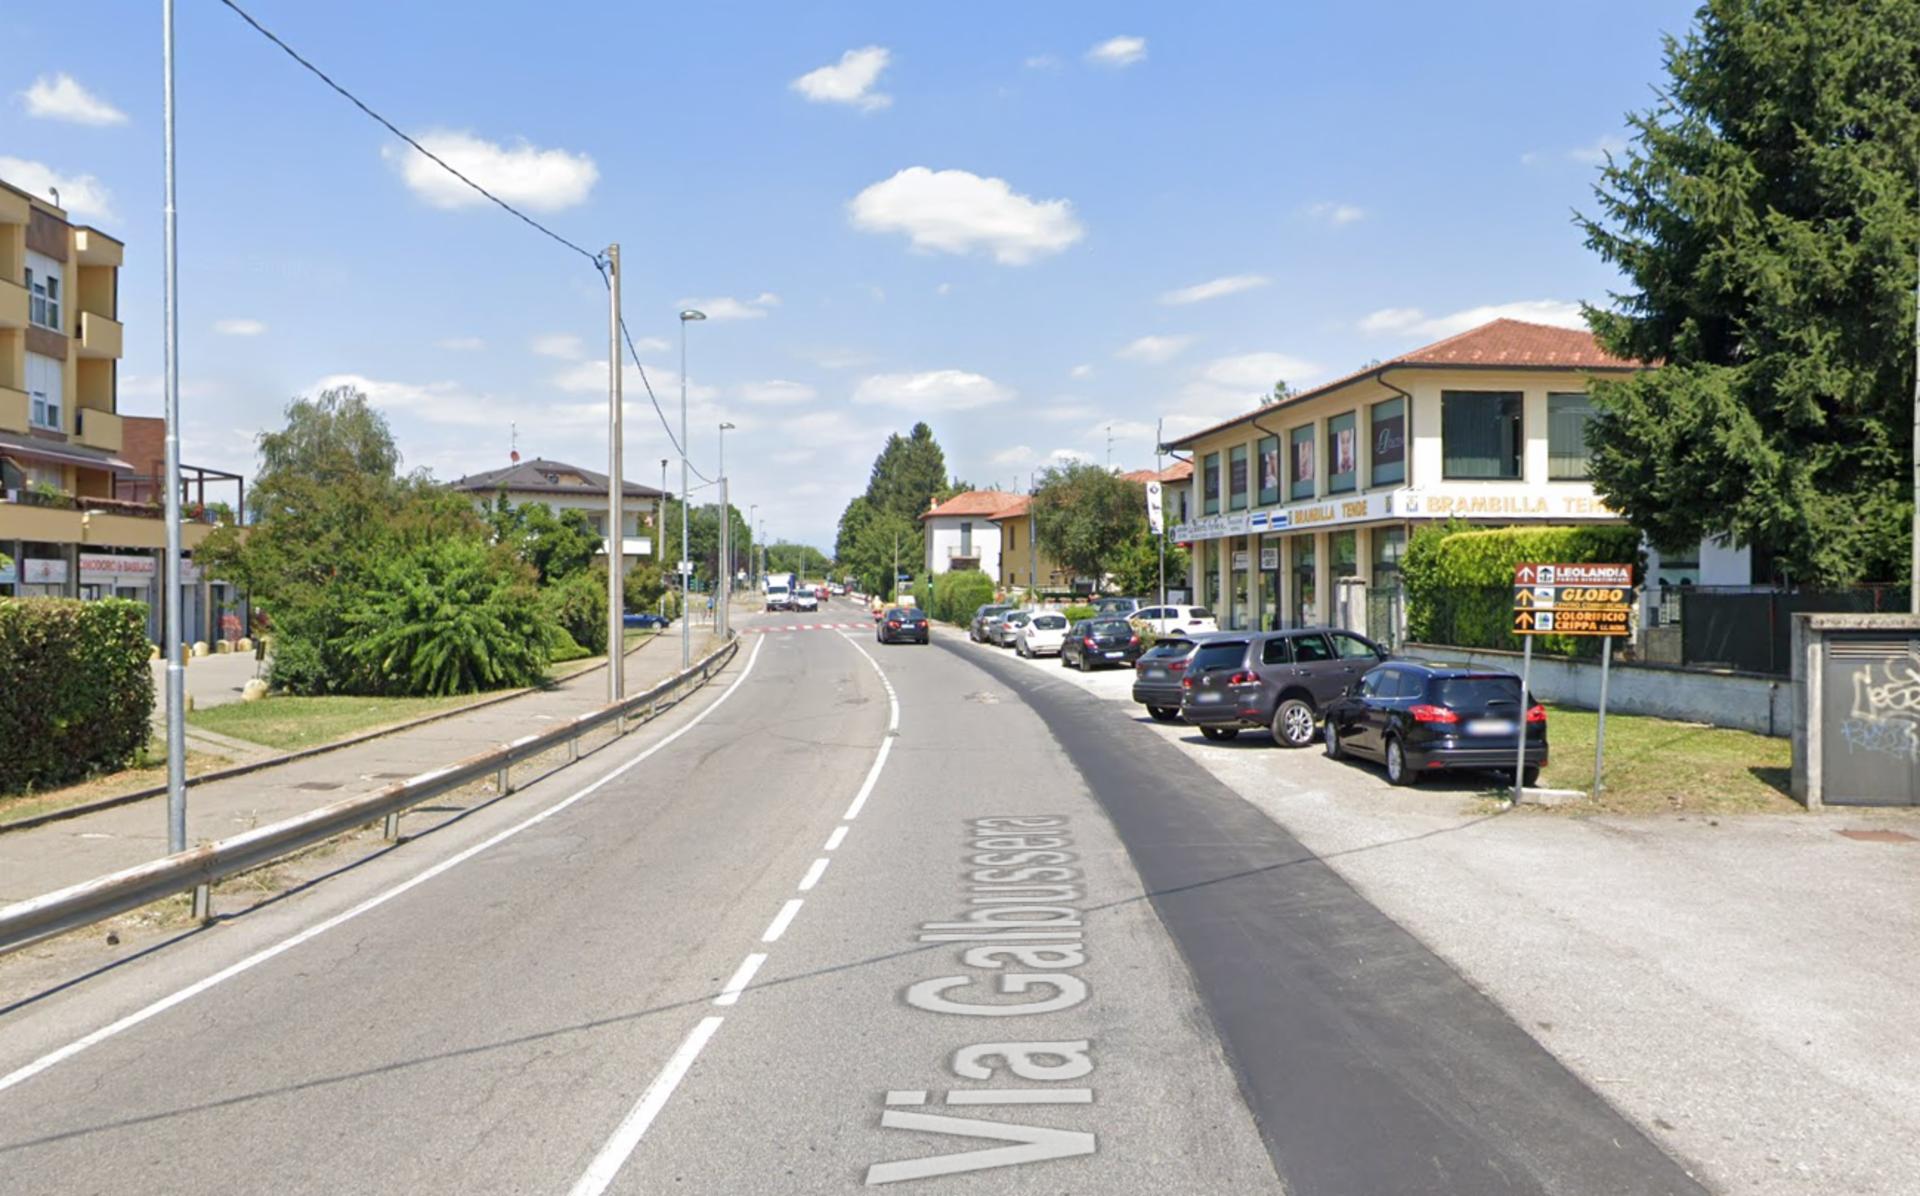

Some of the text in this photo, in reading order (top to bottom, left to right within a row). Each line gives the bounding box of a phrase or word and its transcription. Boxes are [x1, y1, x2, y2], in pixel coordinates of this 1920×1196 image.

[1426, 496, 1625, 513] BRAMBILLA TEN
[1294, 500, 1368, 524] BRAMBILLA TENDE
[80, 559, 116, 571] OMODORO
[1556, 567, 1628, 577] LEOLANDIA
[1562, 589, 1623, 602] GLOBO
[1555, 612, 1626, 622] COLORIFICIO
[1555, 621, 1597, 631] CRIPPA
